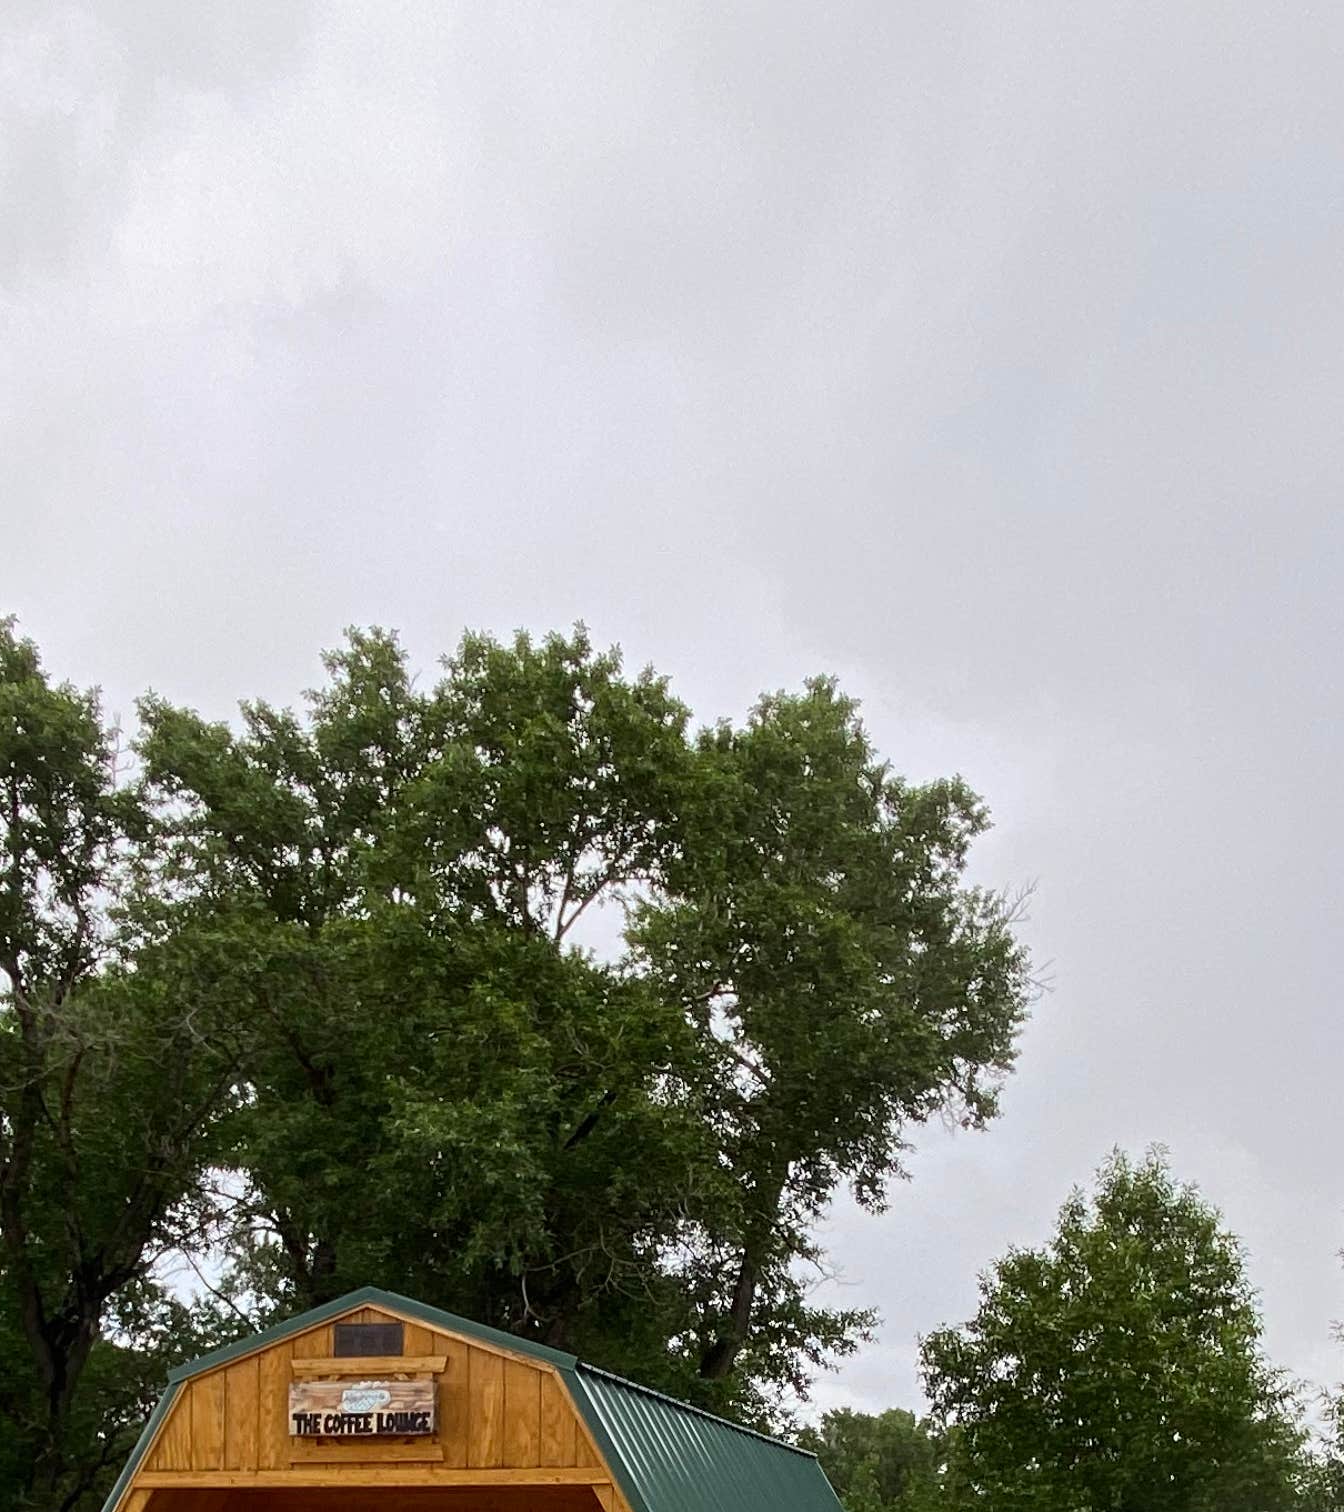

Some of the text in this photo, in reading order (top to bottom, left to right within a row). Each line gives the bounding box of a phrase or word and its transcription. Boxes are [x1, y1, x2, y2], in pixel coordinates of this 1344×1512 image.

[292, 1411, 431, 1434] THE COFFEE LOUNGE
